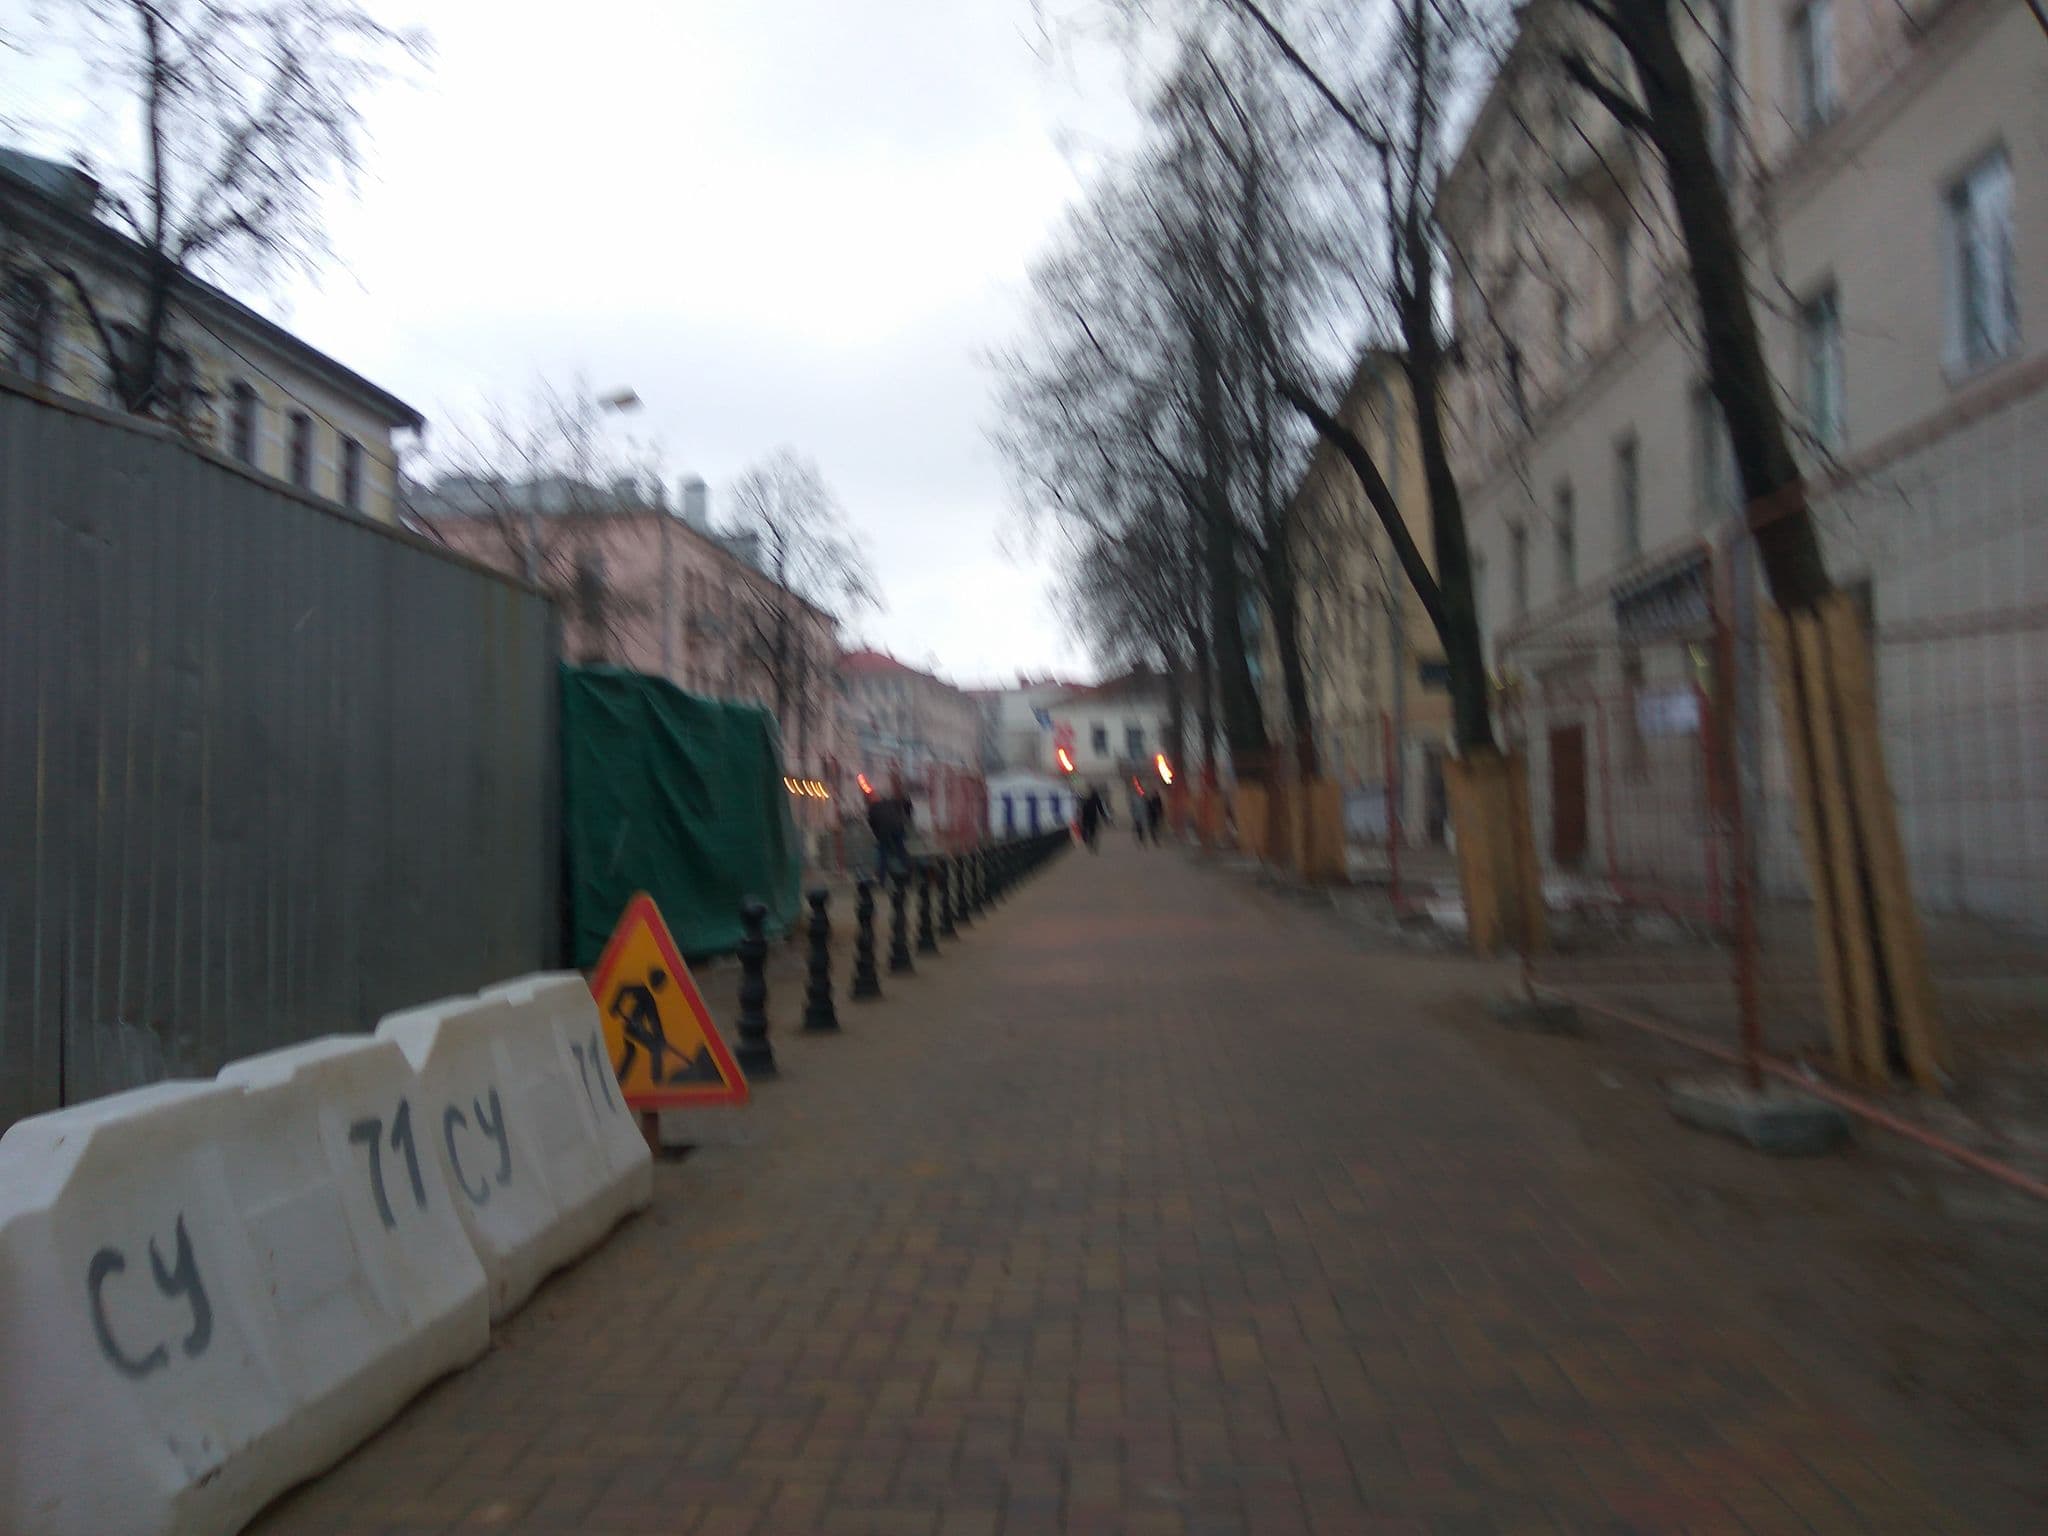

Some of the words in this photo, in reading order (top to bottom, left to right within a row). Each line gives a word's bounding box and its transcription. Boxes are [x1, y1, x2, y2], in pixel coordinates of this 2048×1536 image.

[88, 1212, 212, 1380] СУ
[349, 1098, 427, 1231] 71
[442, 1087, 512, 1207] СУ
